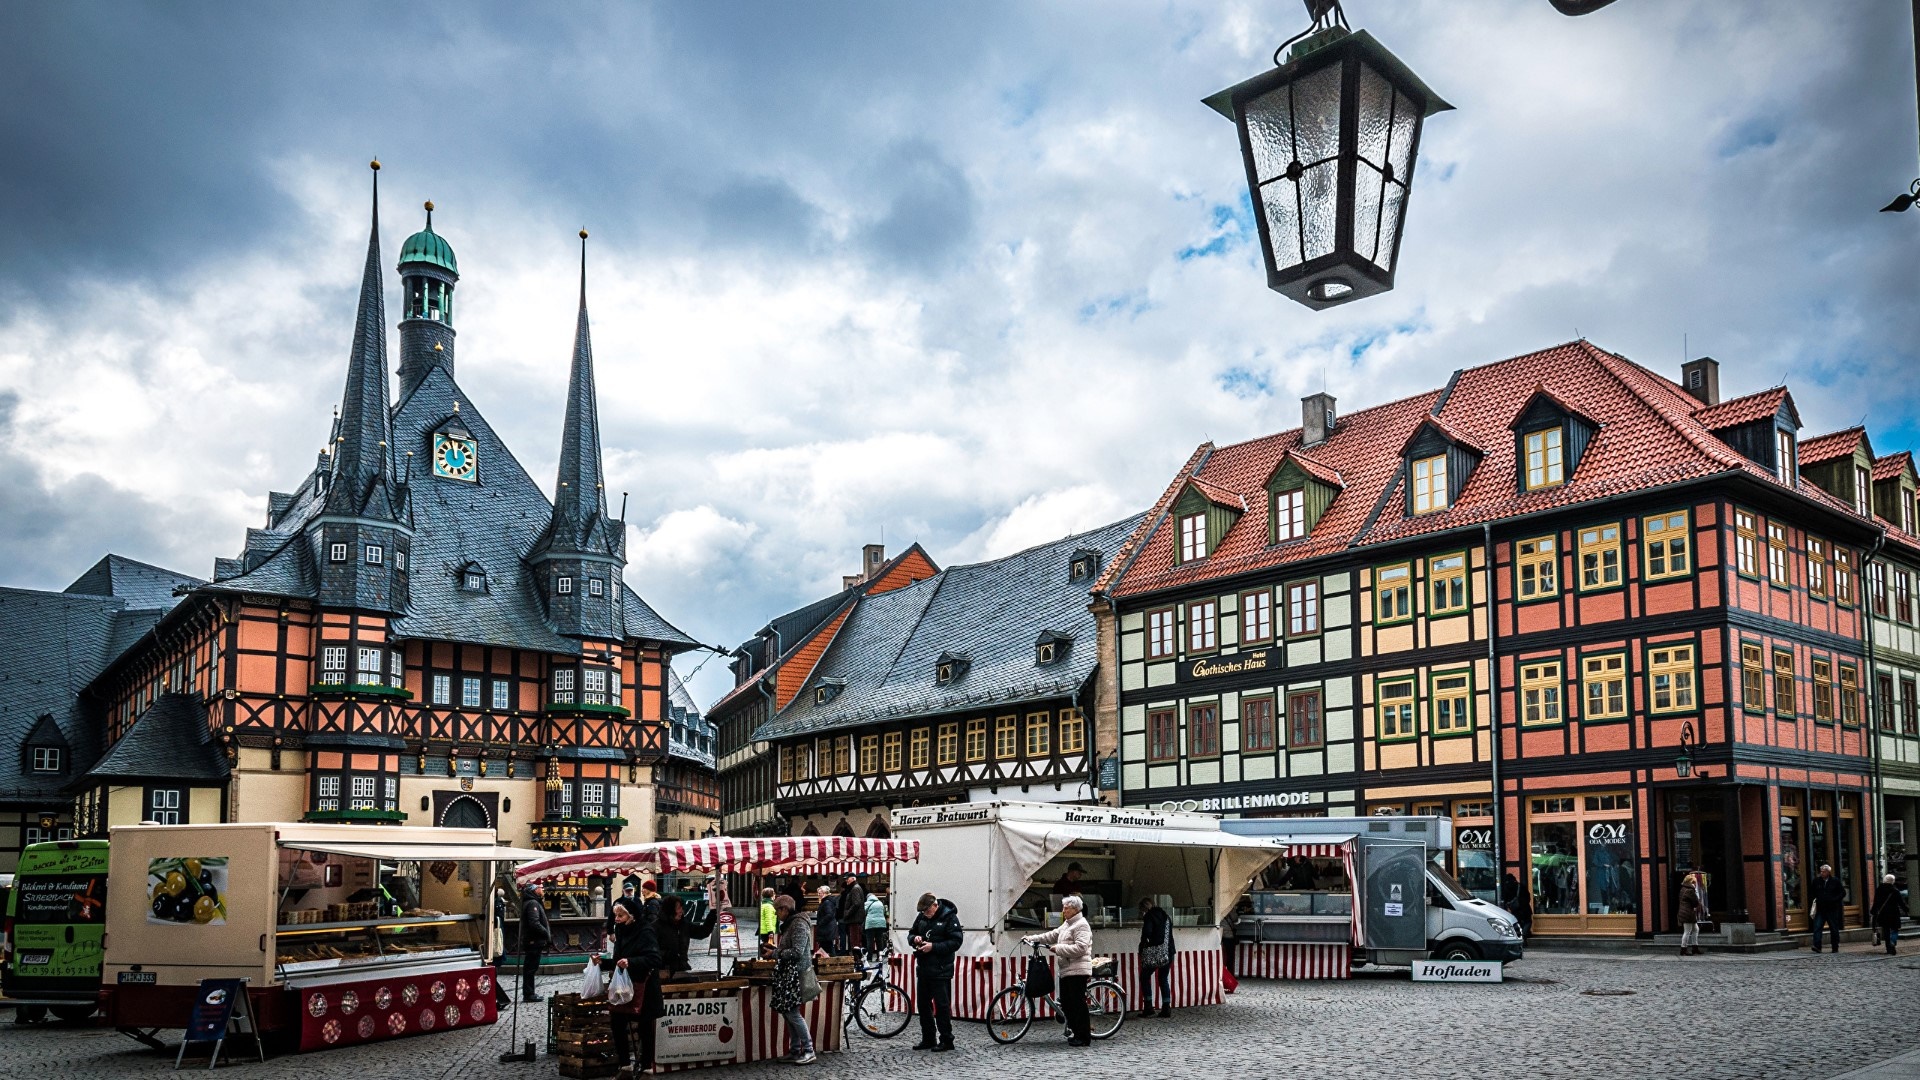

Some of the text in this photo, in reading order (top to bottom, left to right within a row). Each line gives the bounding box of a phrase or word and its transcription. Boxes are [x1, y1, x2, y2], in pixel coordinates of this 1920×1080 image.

[1192, 659, 1266, 677] Gothisches Haus
[1202, 791, 1310, 811] BRILLENMODE
[900, 809, 988, 825] Harzer Bratwurst
[1065, 812, 1165, 826] Harzer Bratwurst
[21, 880, 89, 891] Bäckerei & Konditorei
[1422, 965, 1491, 979] Hofladen
[661, 1019, 673, 1028] aus
[668, 1023, 717, 1034] WERNIGERODE
